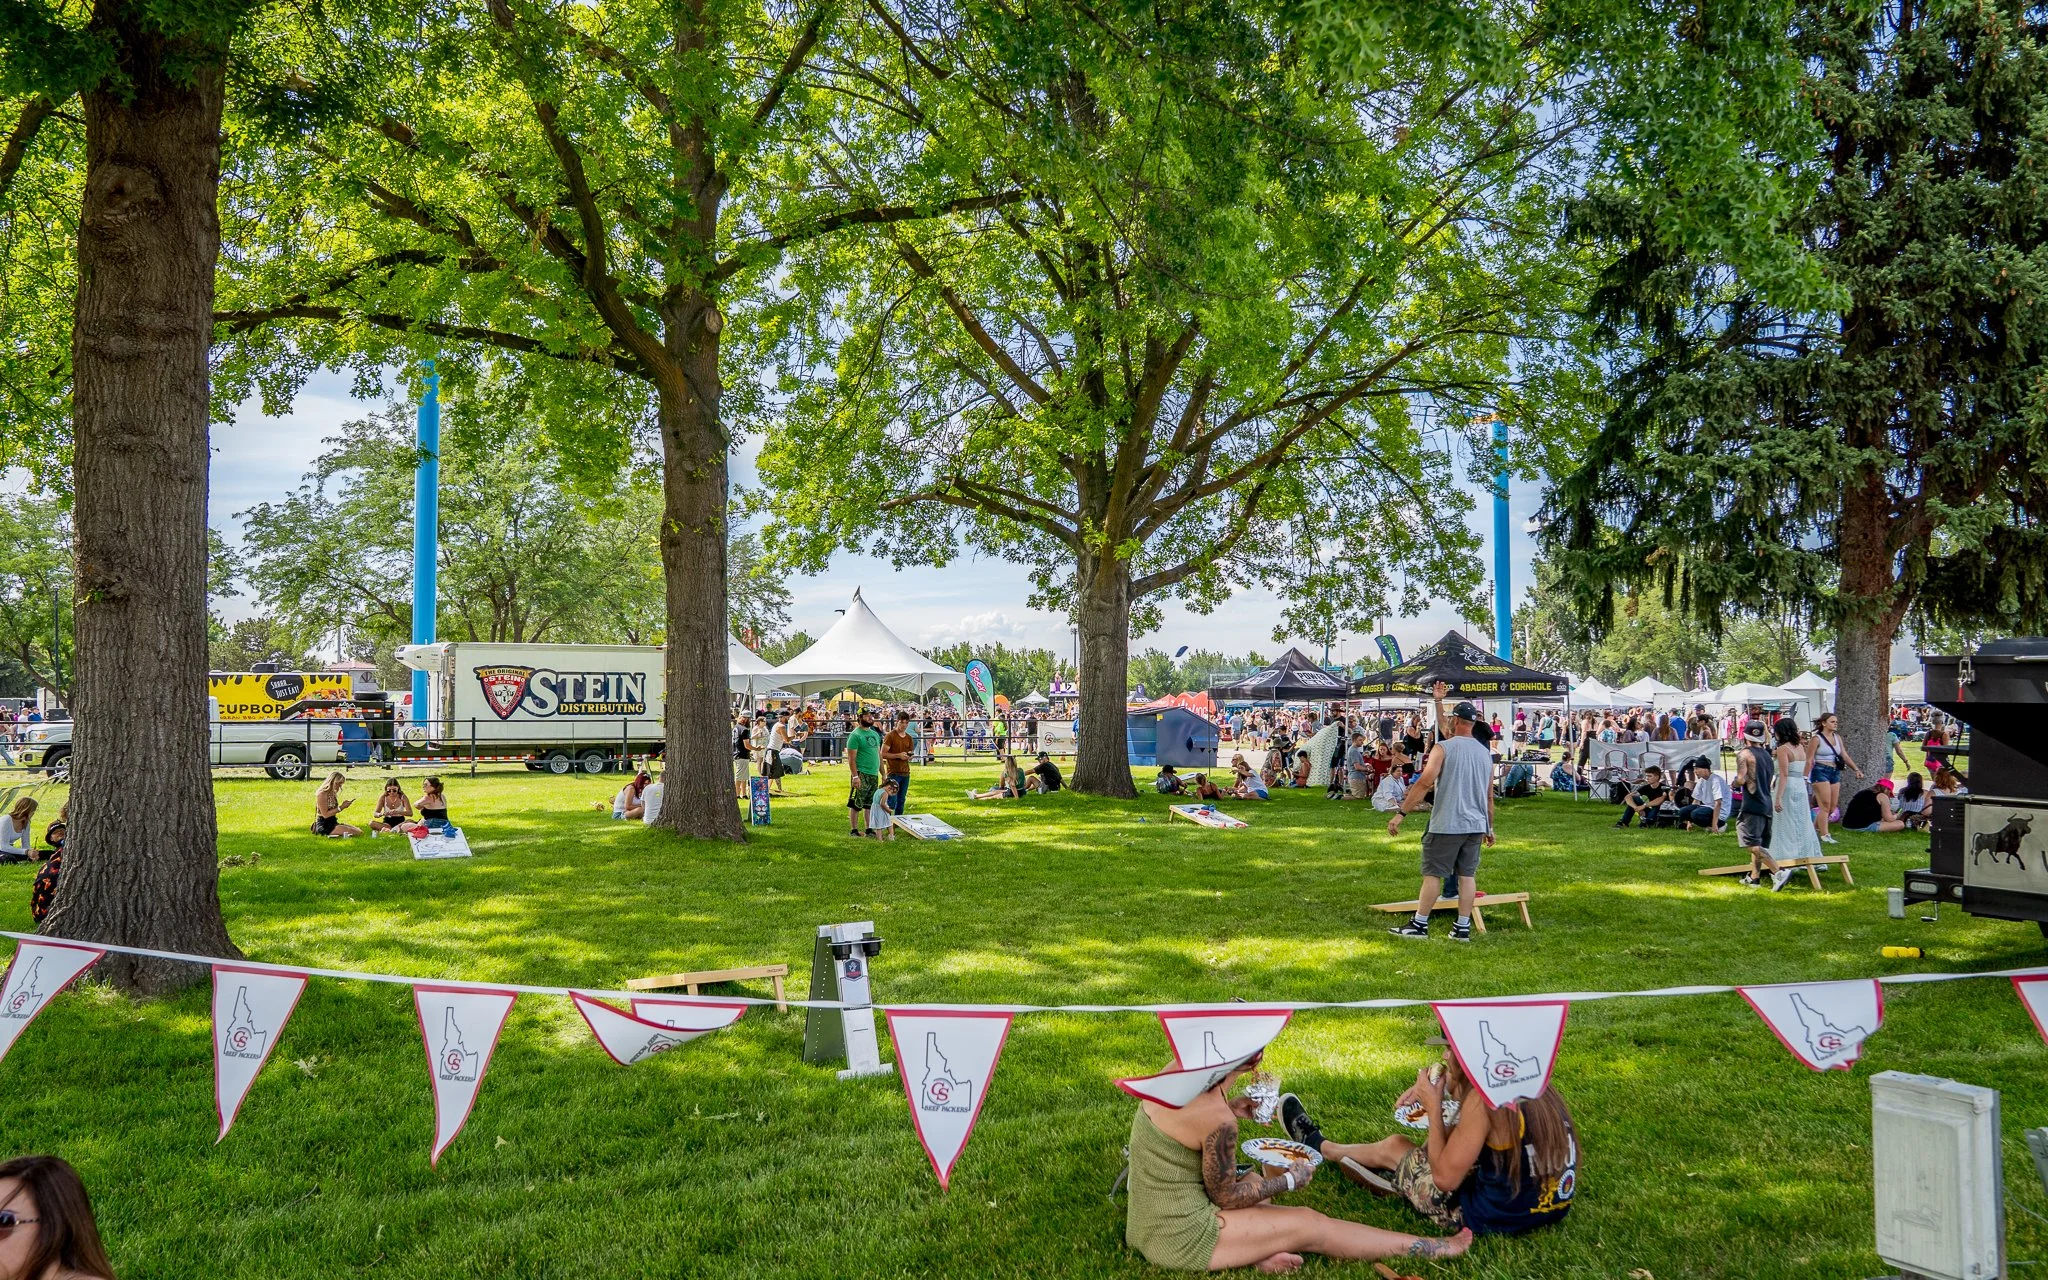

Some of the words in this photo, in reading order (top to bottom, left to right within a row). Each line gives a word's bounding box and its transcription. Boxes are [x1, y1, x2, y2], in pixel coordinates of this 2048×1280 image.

[488, 674, 521, 682] STEIN
[498, 668, 526, 676] ORIGINAL
[969, 667, 987, 692] Beer
[520, 670, 644, 715] STEIN
[1360, 683, 1385, 693] 4BAGGER
[1460, 682, 1498, 692] 4BAGGER
[1509, 682, 1552, 691] CORNHOLE
[559, 703, 644, 713] DISTRIBUTING
[233, 1030, 249, 1048] CS
[447, 1053, 461, 1071] CS
[1495, 1063, 1515, 1078] CS
[931, 1081, 949, 1102] CS
